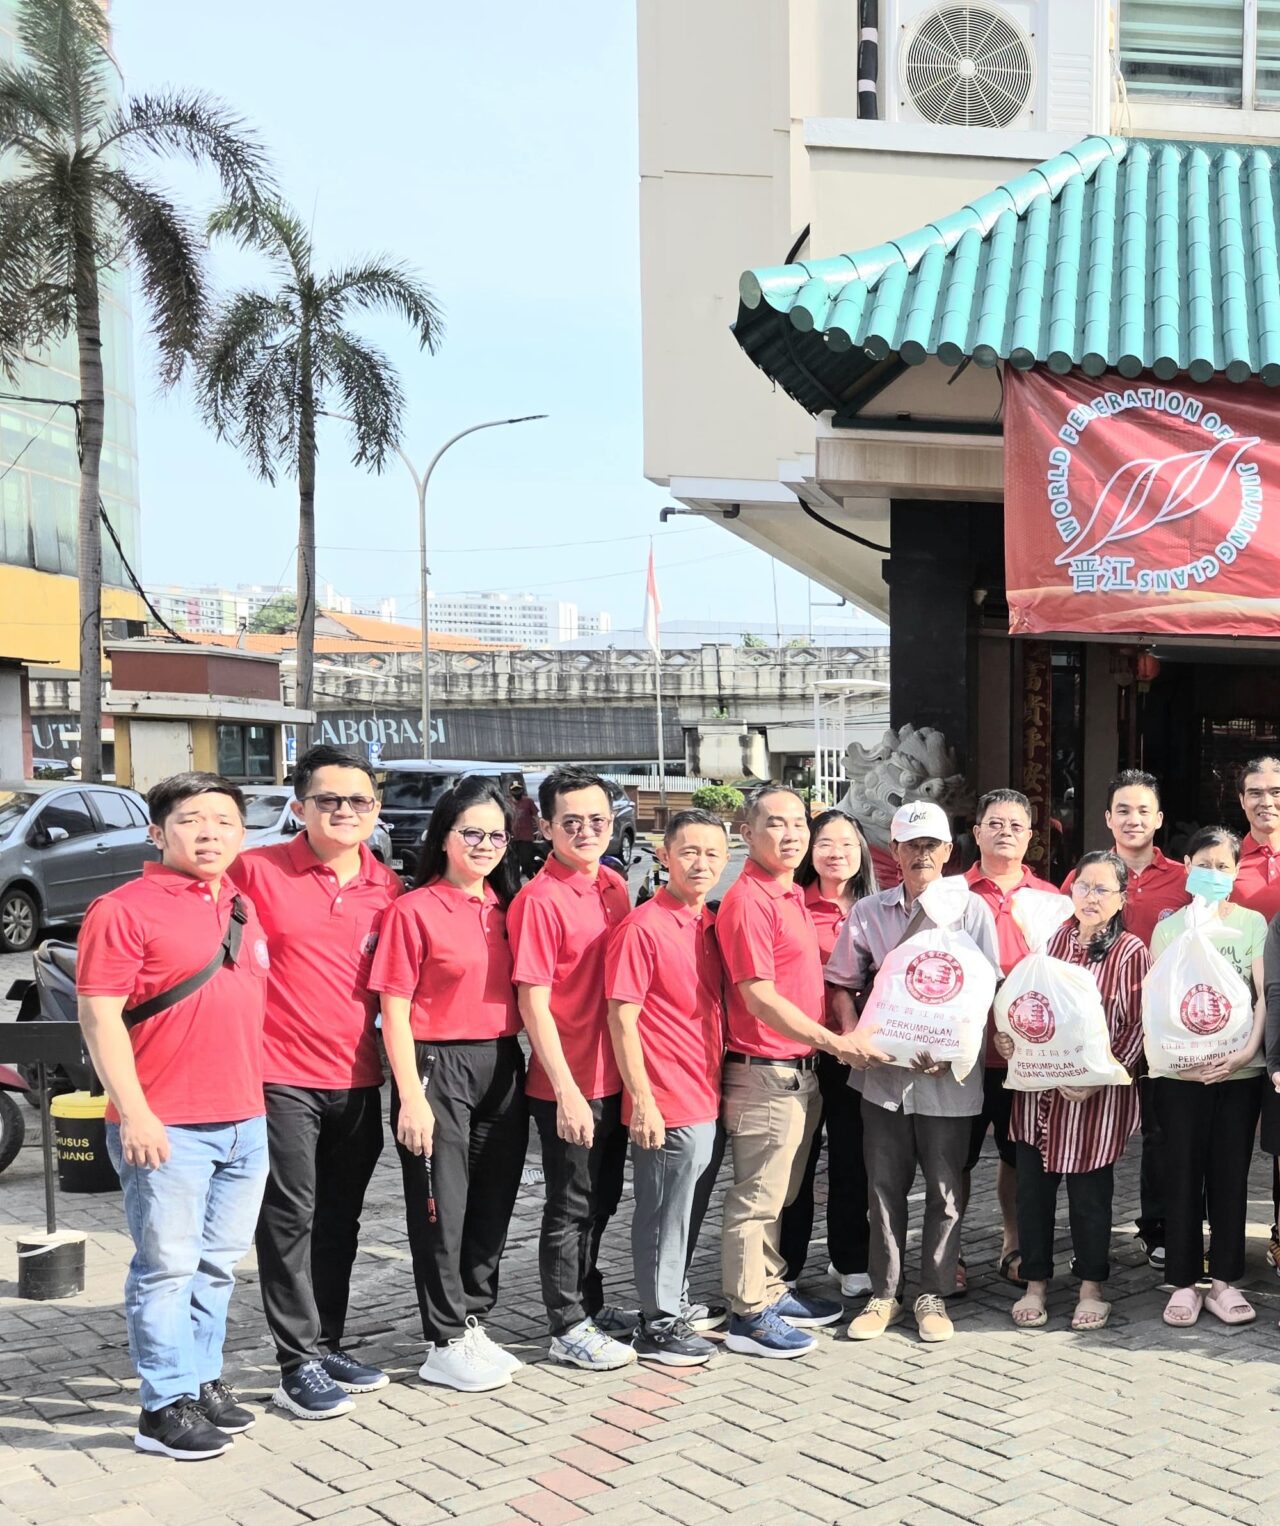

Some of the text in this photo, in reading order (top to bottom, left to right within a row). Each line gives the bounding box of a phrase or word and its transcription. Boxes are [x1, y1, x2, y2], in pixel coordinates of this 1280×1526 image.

[1050, 391, 1261, 588] WORLD FEDERATION OF JINJIANG CLANS
[886, 1018, 953, 1037] PERKUMPULAN
[913, 1033, 960, 1048] INDONESIA
[1017, 1061, 1075, 1070] PERKUMPULAN
[1045, 1066, 1089, 1078] INDONESIA
